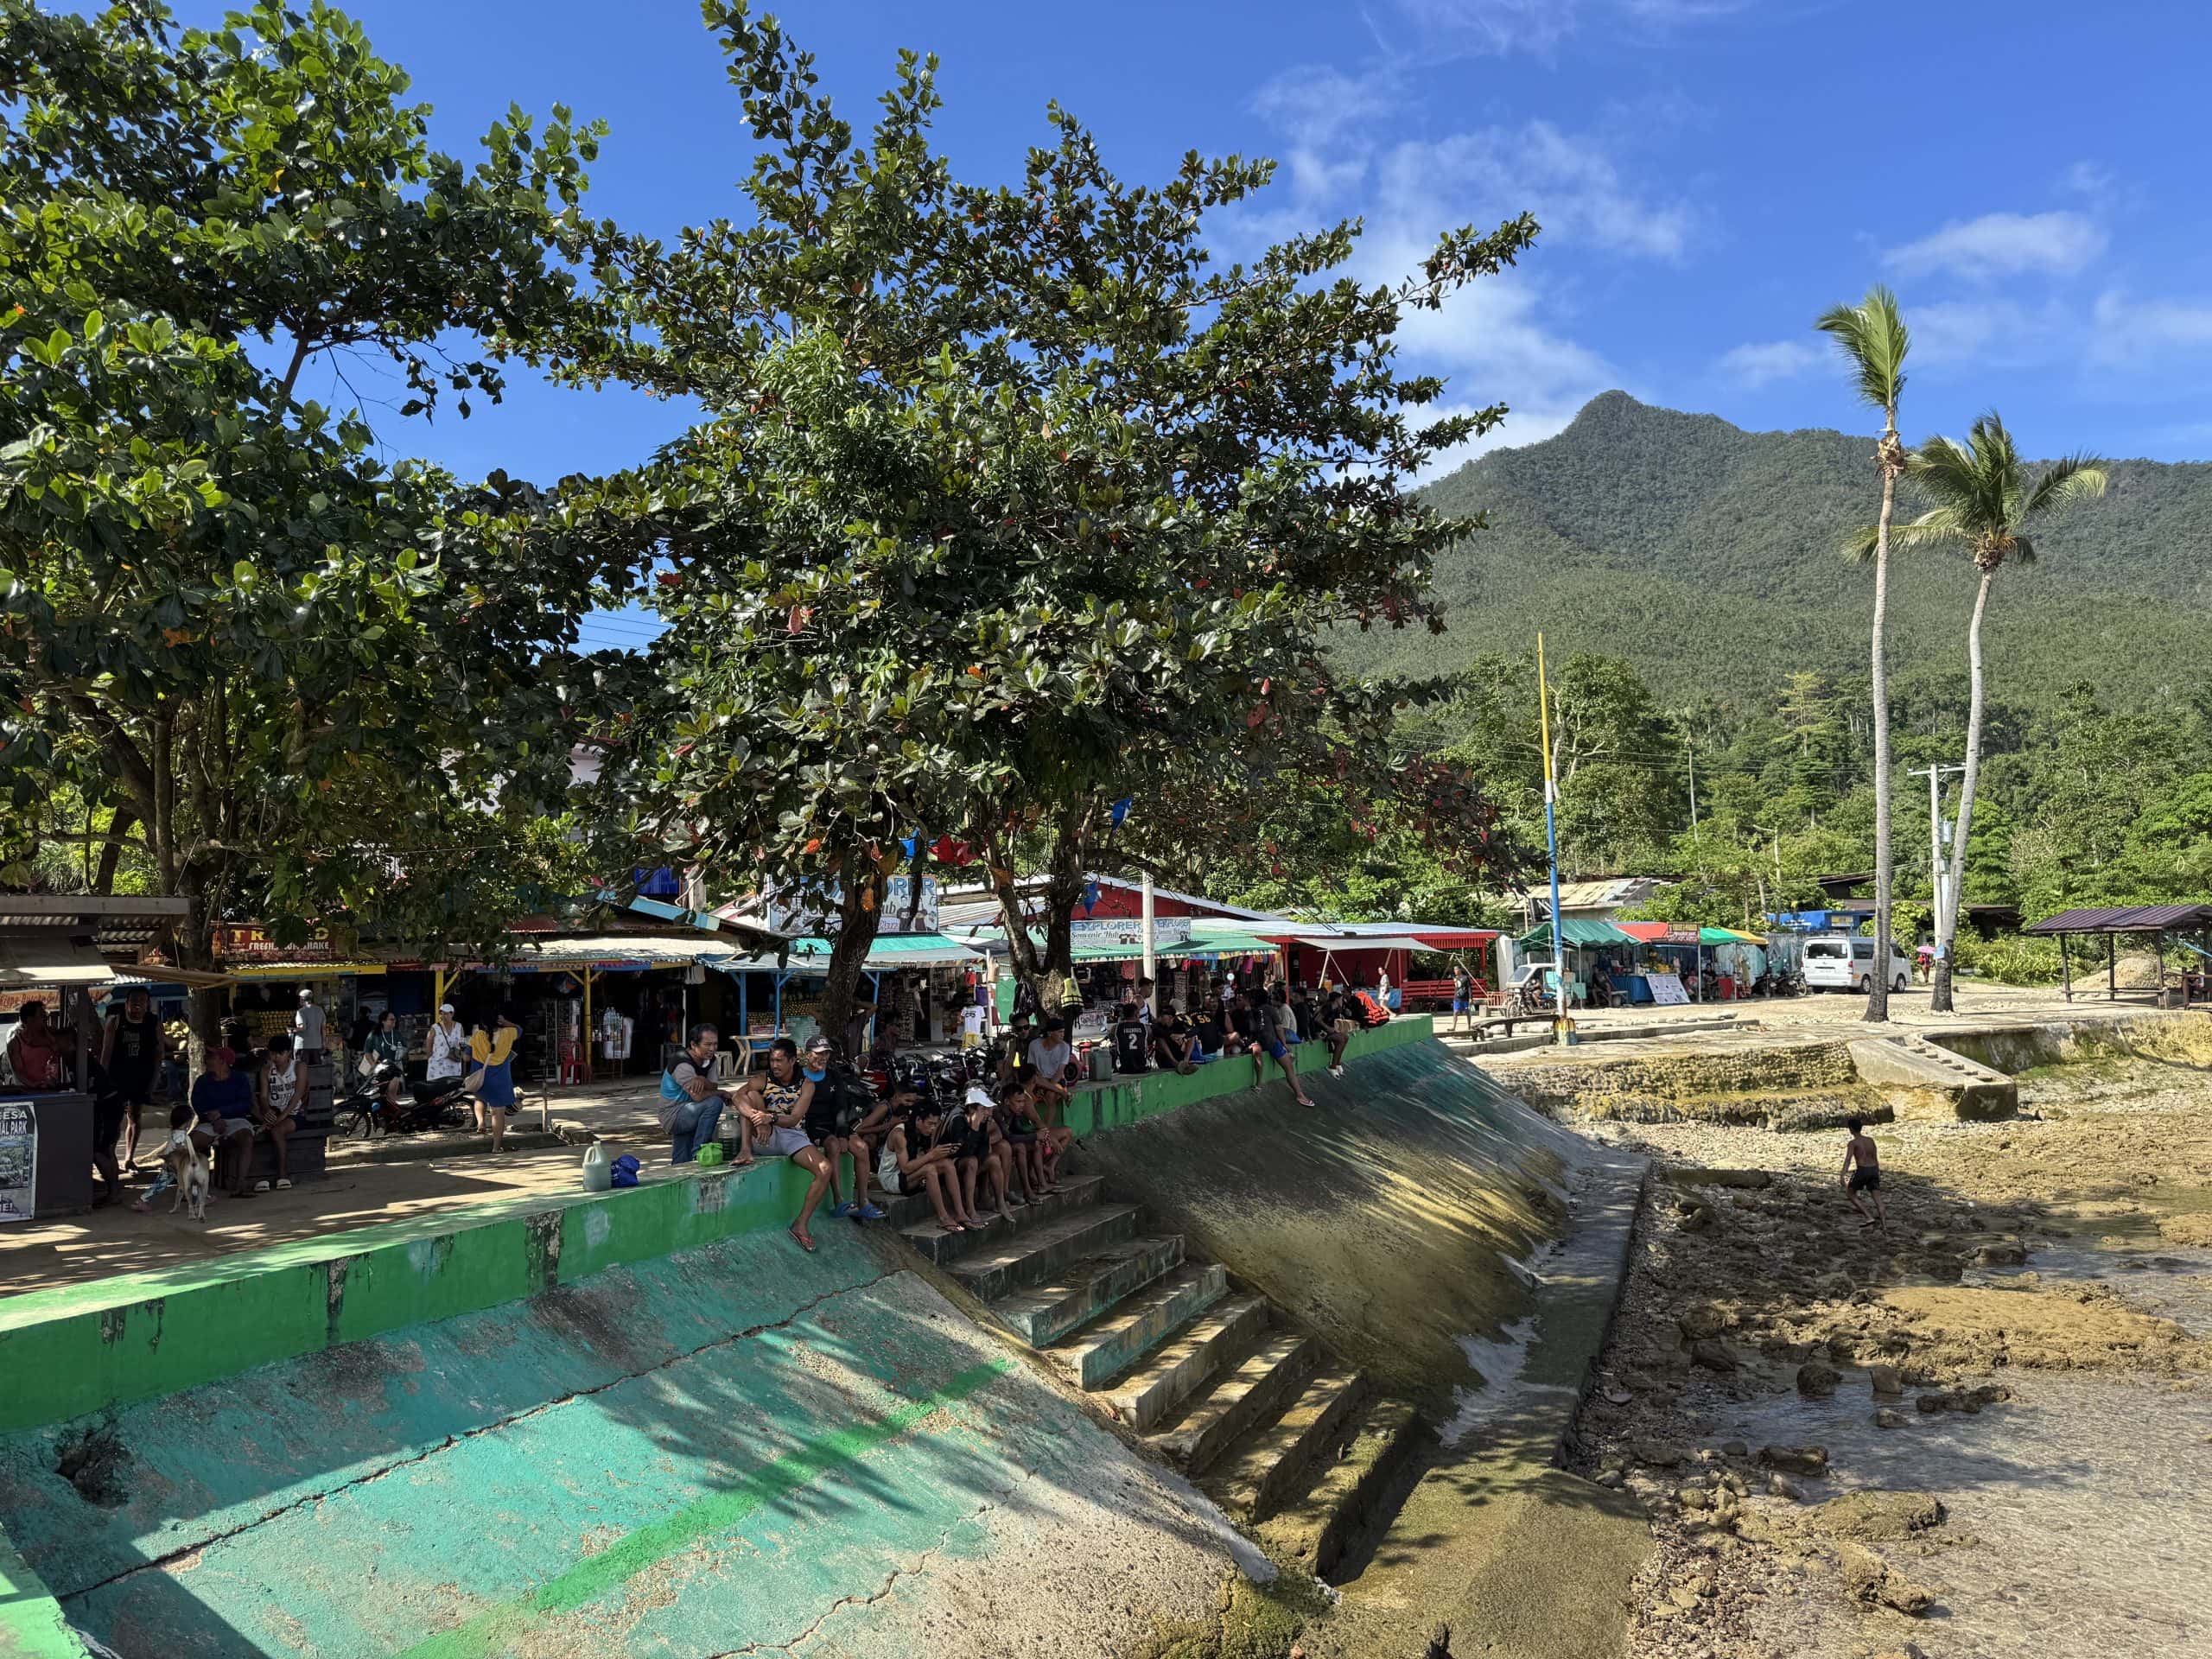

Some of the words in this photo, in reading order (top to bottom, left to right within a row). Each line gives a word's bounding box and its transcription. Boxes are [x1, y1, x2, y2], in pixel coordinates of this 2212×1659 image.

[1072, 921, 1141, 931] EXPLORER
[1128, 1033, 1138, 1050] 2
[10, 1120, 28, 1135] PARK
